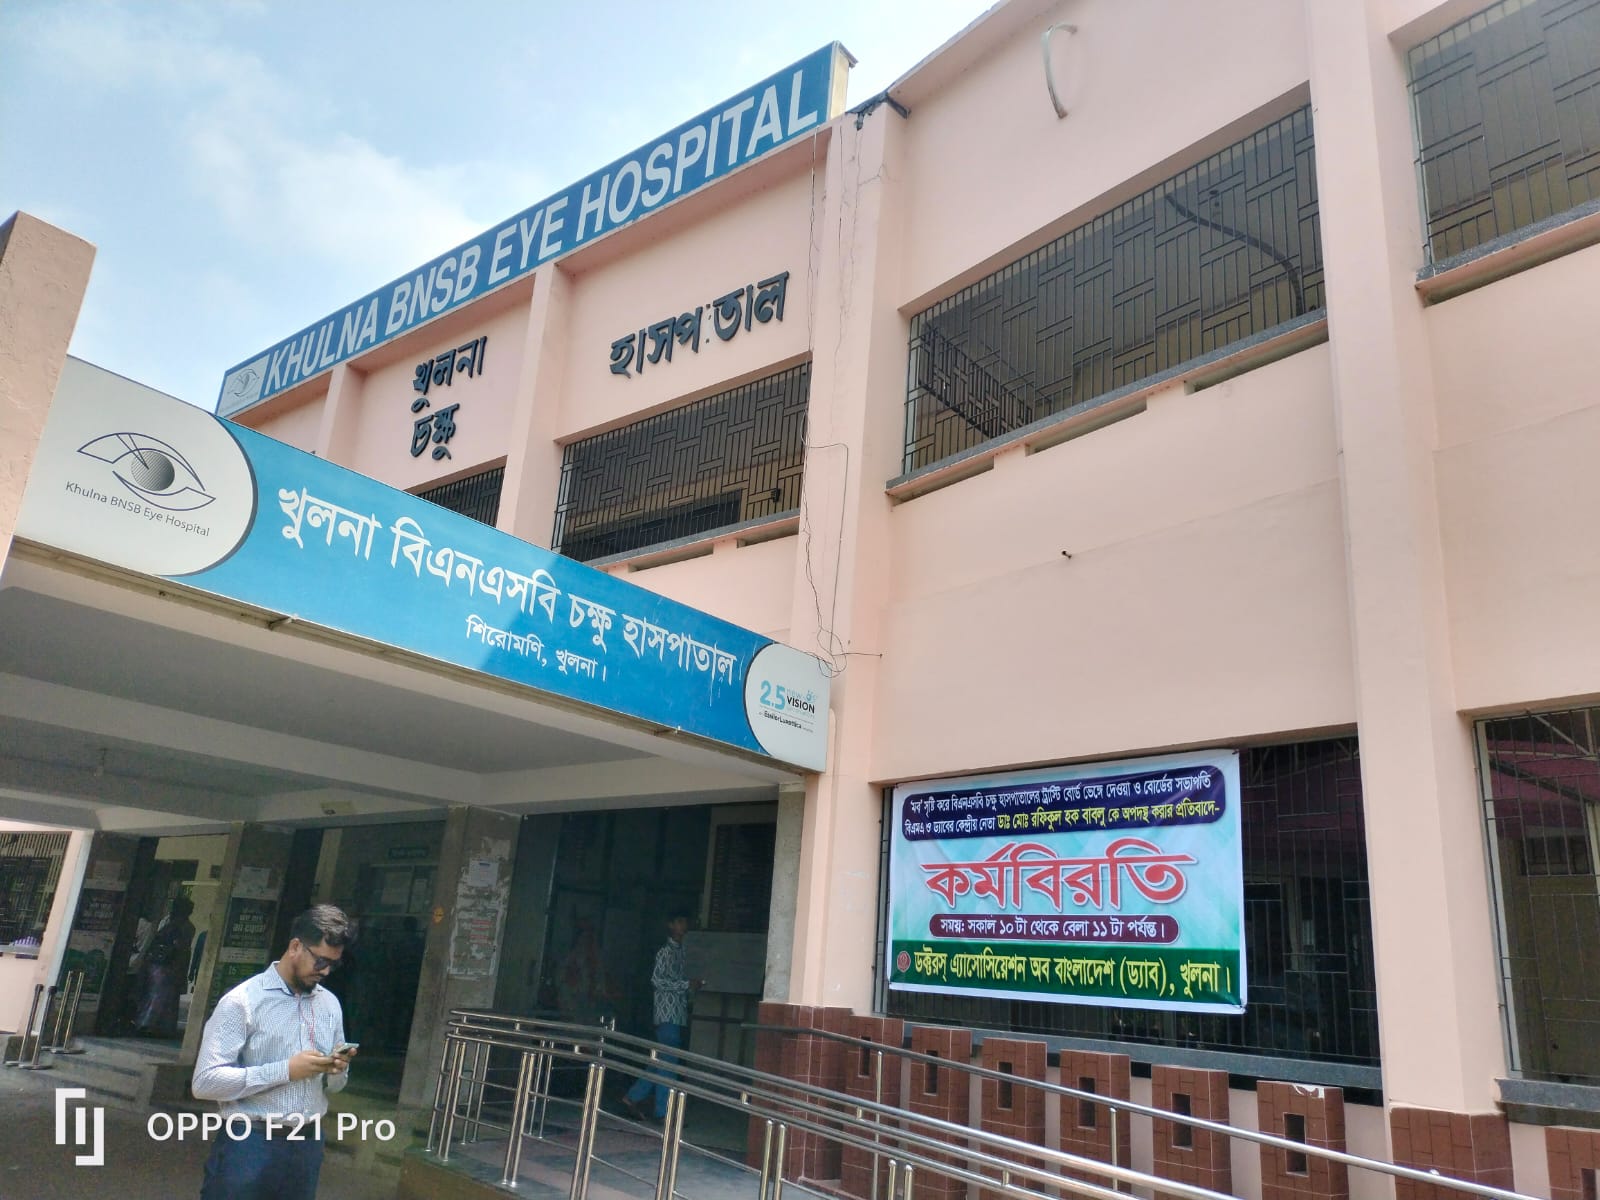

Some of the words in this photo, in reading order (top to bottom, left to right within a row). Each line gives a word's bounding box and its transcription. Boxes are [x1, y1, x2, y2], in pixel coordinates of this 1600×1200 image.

[264, 297, 379, 395] KHULNA
[385, 245, 480, 335] BNSB
[488, 196, 569, 285] EYE
[575, 70, 818, 242] HOSPITAL
[610, 271, 790, 378] হাসপতাল
[411, 336, 488, 413] খুলনা
[411, 403, 460, 460] চক্ষু
[65, 481, 107, 503] Khulna
[110, 496, 141, 514] BNSB
[143, 507, 163, 521] Eye
[166, 514, 210, 537] Hospital
[278, 487, 382, 560] খুলনা
[390, 517, 561, 624] বিএনএসবি
[567, 593, 617, 654] চক্ষু
[622, 613, 737, 687] হাসপাতাল
[465, 614, 547, 667] শিরোমণি,
[760, 680, 785, 710] 2.5
[787, 696, 815, 714] VISION
[936, 799, 950, 811] করে
[951, 792, 984, 811] বিএনএসবি
[999, 789, 1040, 807] হাসপাতালের
[1063, 782, 1081, 801] বোর্ড
[1106, 781, 1131, 798] দেওয়া
[1134, 783, 1141, 794] ও
[1143, 773, 1173, 796] বোর্ডের
[1175, 770, 1212, 792] সভাপতি
[925, 822, 932, 833] ও
[956, 814, 978, 834] কেন্দ্রীয়
[979, 817, 996, 831] নেতা
[1031, 807, 1062, 832] রফিকুল
[1064, 808, 1080, 827] হক
[1082, 806, 1106, 828] বাবলু
[1108, 808, 1120, 822] কে
[1151, 803, 1173, 819] করার
[919, 837, 1198, 913] কর্মবিরতি
[967, 918, 997, 935] সকাল
[1031, 918, 1060, 936] থেকে
[1062, 920, 1089, 936] বেলা
[1028, 955, 1051, 984] অব
[1053, 956, 1116, 987] বাংলাদেশ
